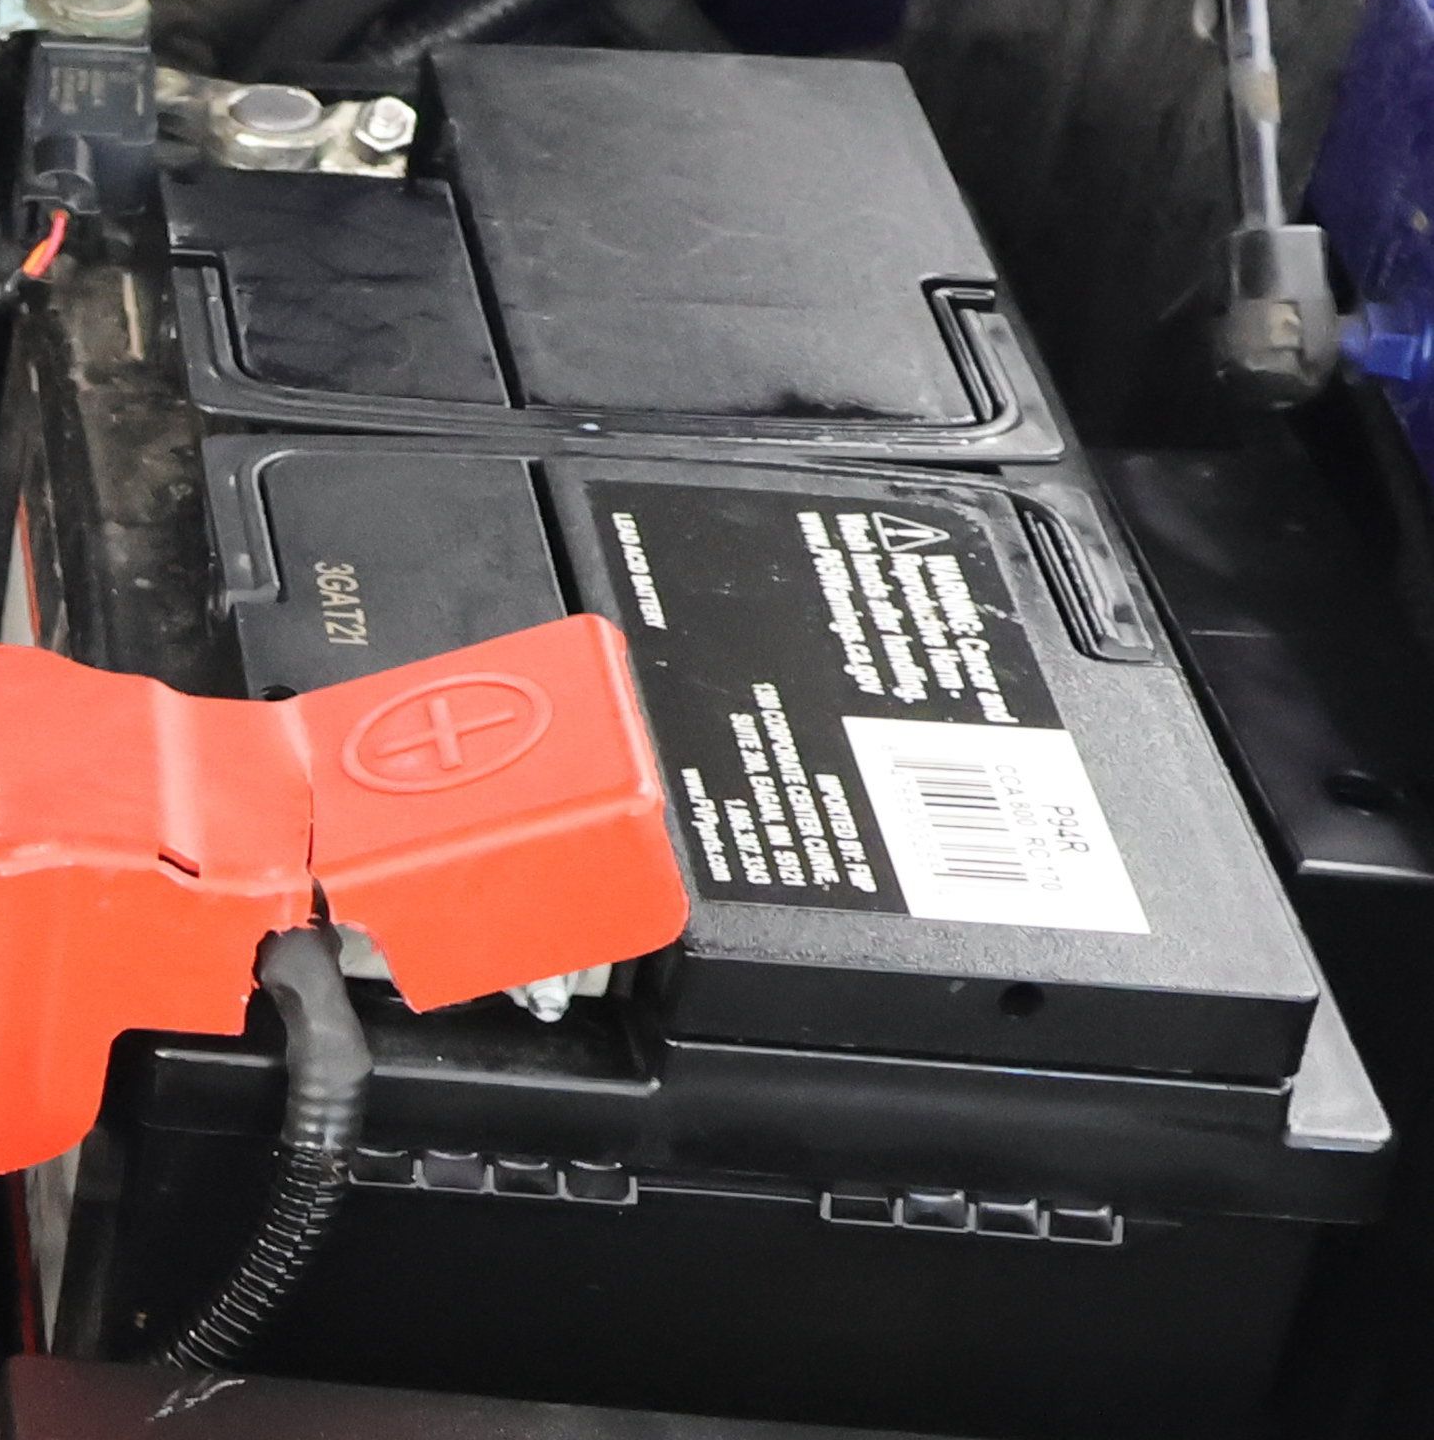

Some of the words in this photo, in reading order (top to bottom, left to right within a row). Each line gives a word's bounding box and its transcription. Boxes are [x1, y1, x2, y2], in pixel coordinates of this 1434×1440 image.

[611, 512, 642, 545] LEAD
[836, 512, 875, 551] Wash
[622, 544, 650, 574] ACID
[850, 553, 894, 598] hands
[314, 560, 369, 646] 3GAT21
[630, 574, 668, 630] BATTERY
[796, 511, 886, 696] www.P65Warnings.ca.gov
[874, 600, 907, 633] after
[890, 553, 950, 647] Reproductive
[926, 649, 964, 689] Harm
[957, 638, 1000, 690] Cancer
[976, 691, 1019, 723] and
[728, 713, 760, 750] SUITE
[761, 710, 810, 785] CORPORATE
[788, 785, 825, 836] CENTER
[995, 764, 1023, 796] CCA
[1009, 802, 1037, 827] 800
[815, 773, 854, 839] IMPORTED
[1043, 804, 1090, 854] P94R
[765, 825, 794, 847] MN
[772, 850, 807, 887] 55121
